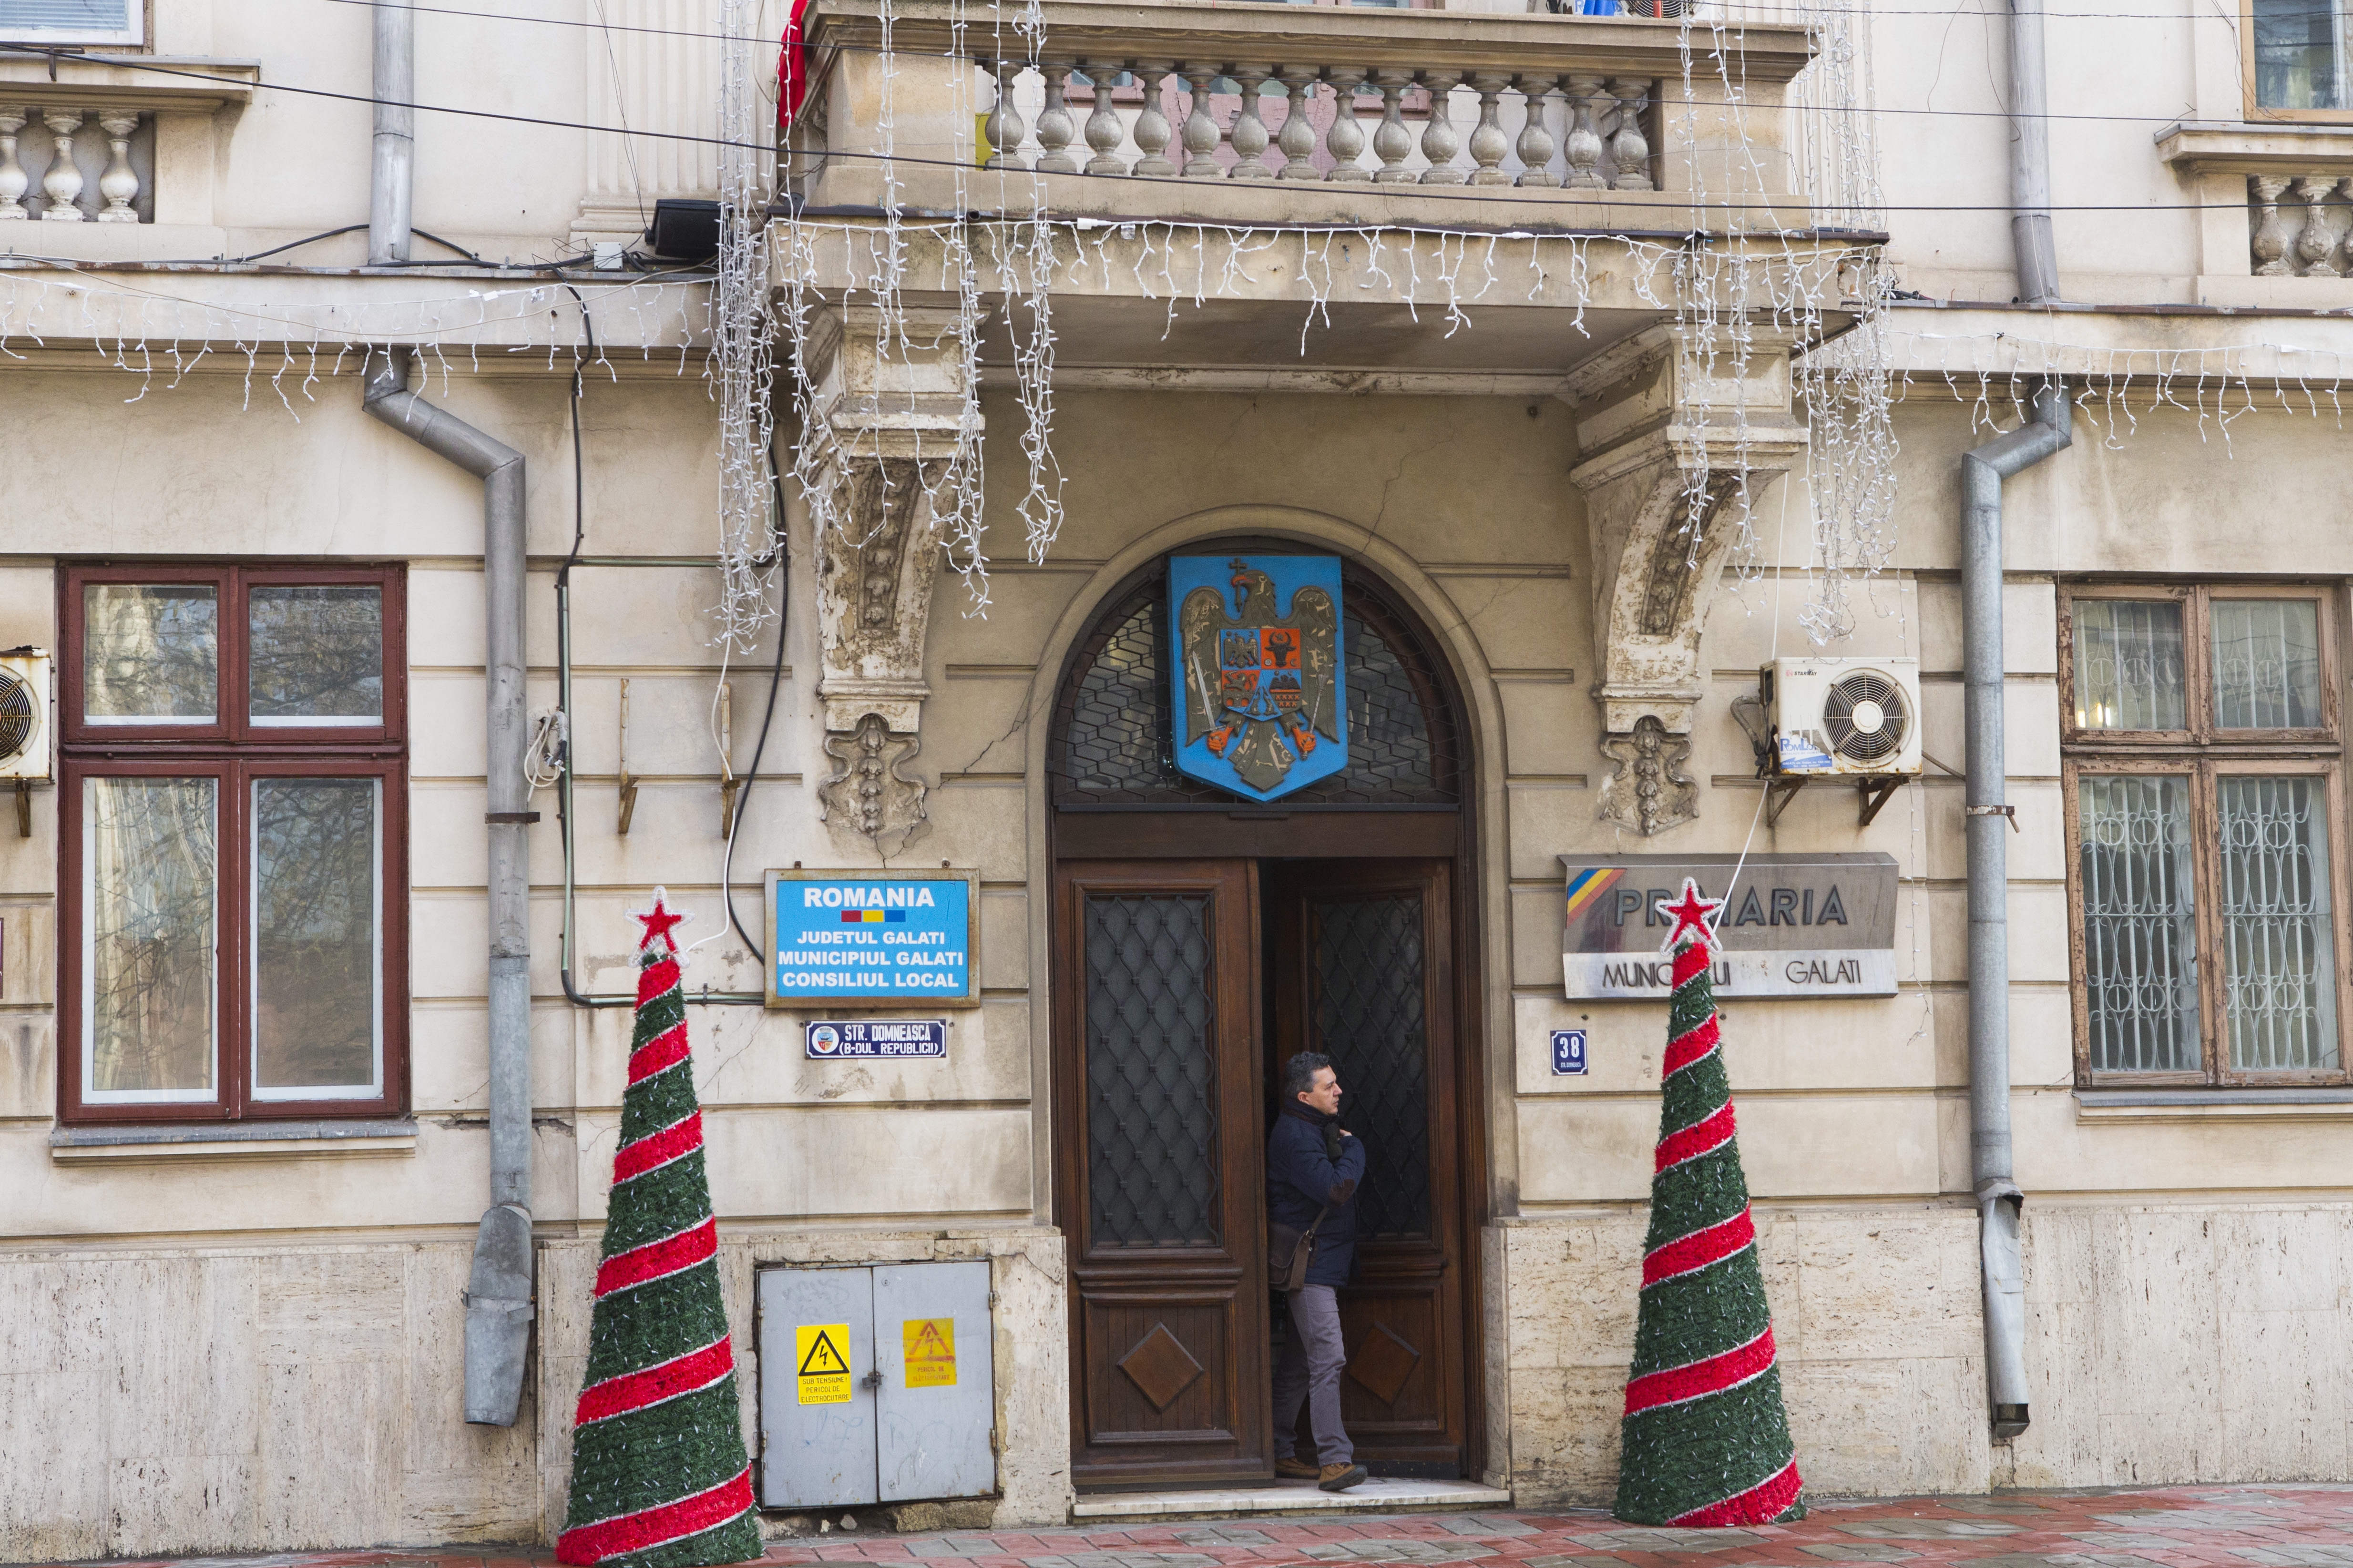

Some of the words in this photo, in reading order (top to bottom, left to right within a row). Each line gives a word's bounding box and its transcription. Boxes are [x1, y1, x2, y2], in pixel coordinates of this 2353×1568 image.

[804, 887, 935, 907] ROMANIA
[1615, 884, 1848, 927] PRARIA
[797, 931, 878, 944] JUDETUL
[883, 932, 945, 945] GALATI
[778, 951, 890, 965] MUNICIPIUL
[896, 952, 963, 966] GALATI
[782, 973, 889, 987] CONSILIUL
[895, 973, 959, 988] LOCAL
[1603, 961, 1731, 988] MUNICUI
[1786, 960, 1861, 984] GALATI
[845, 1024, 868, 1041] STR.
[871, 1022, 931, 1041] DOMNEASCĂ
[839, 1041, 875, 1055] (B-DUL
[880, 1042, 939, 1055] REPUBLICII)
[1559, 1036, 1580, 1059] 38
[801, 1394, 849, 1403] ELECTROCUTARE
